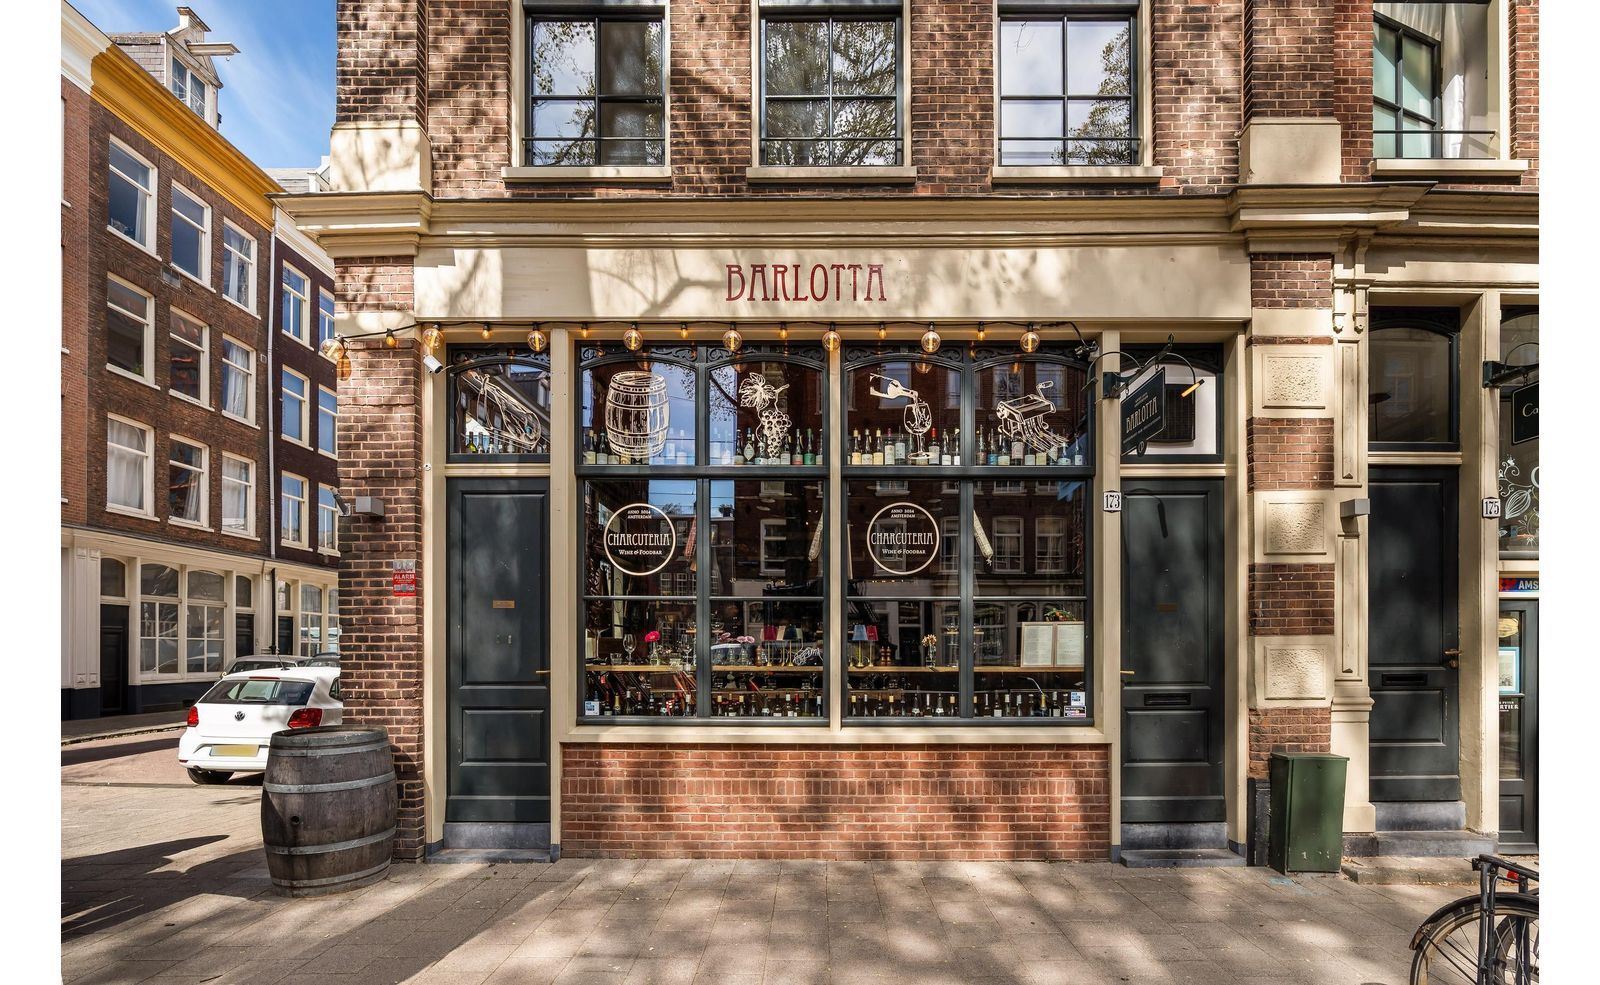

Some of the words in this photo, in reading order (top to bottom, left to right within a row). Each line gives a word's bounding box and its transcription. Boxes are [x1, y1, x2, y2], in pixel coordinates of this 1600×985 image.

[725, 263, 887, 302] BARLOTTA
[1126, 396, 1158, 434] BARLOTTA
[1105, 494, 1120, 509] 173
[1484, 501, 1500, 515] 175
[608, 534, 670, 546] CHARCUTERIA
[871, 532, 934, 544] CHARCUTERIA
